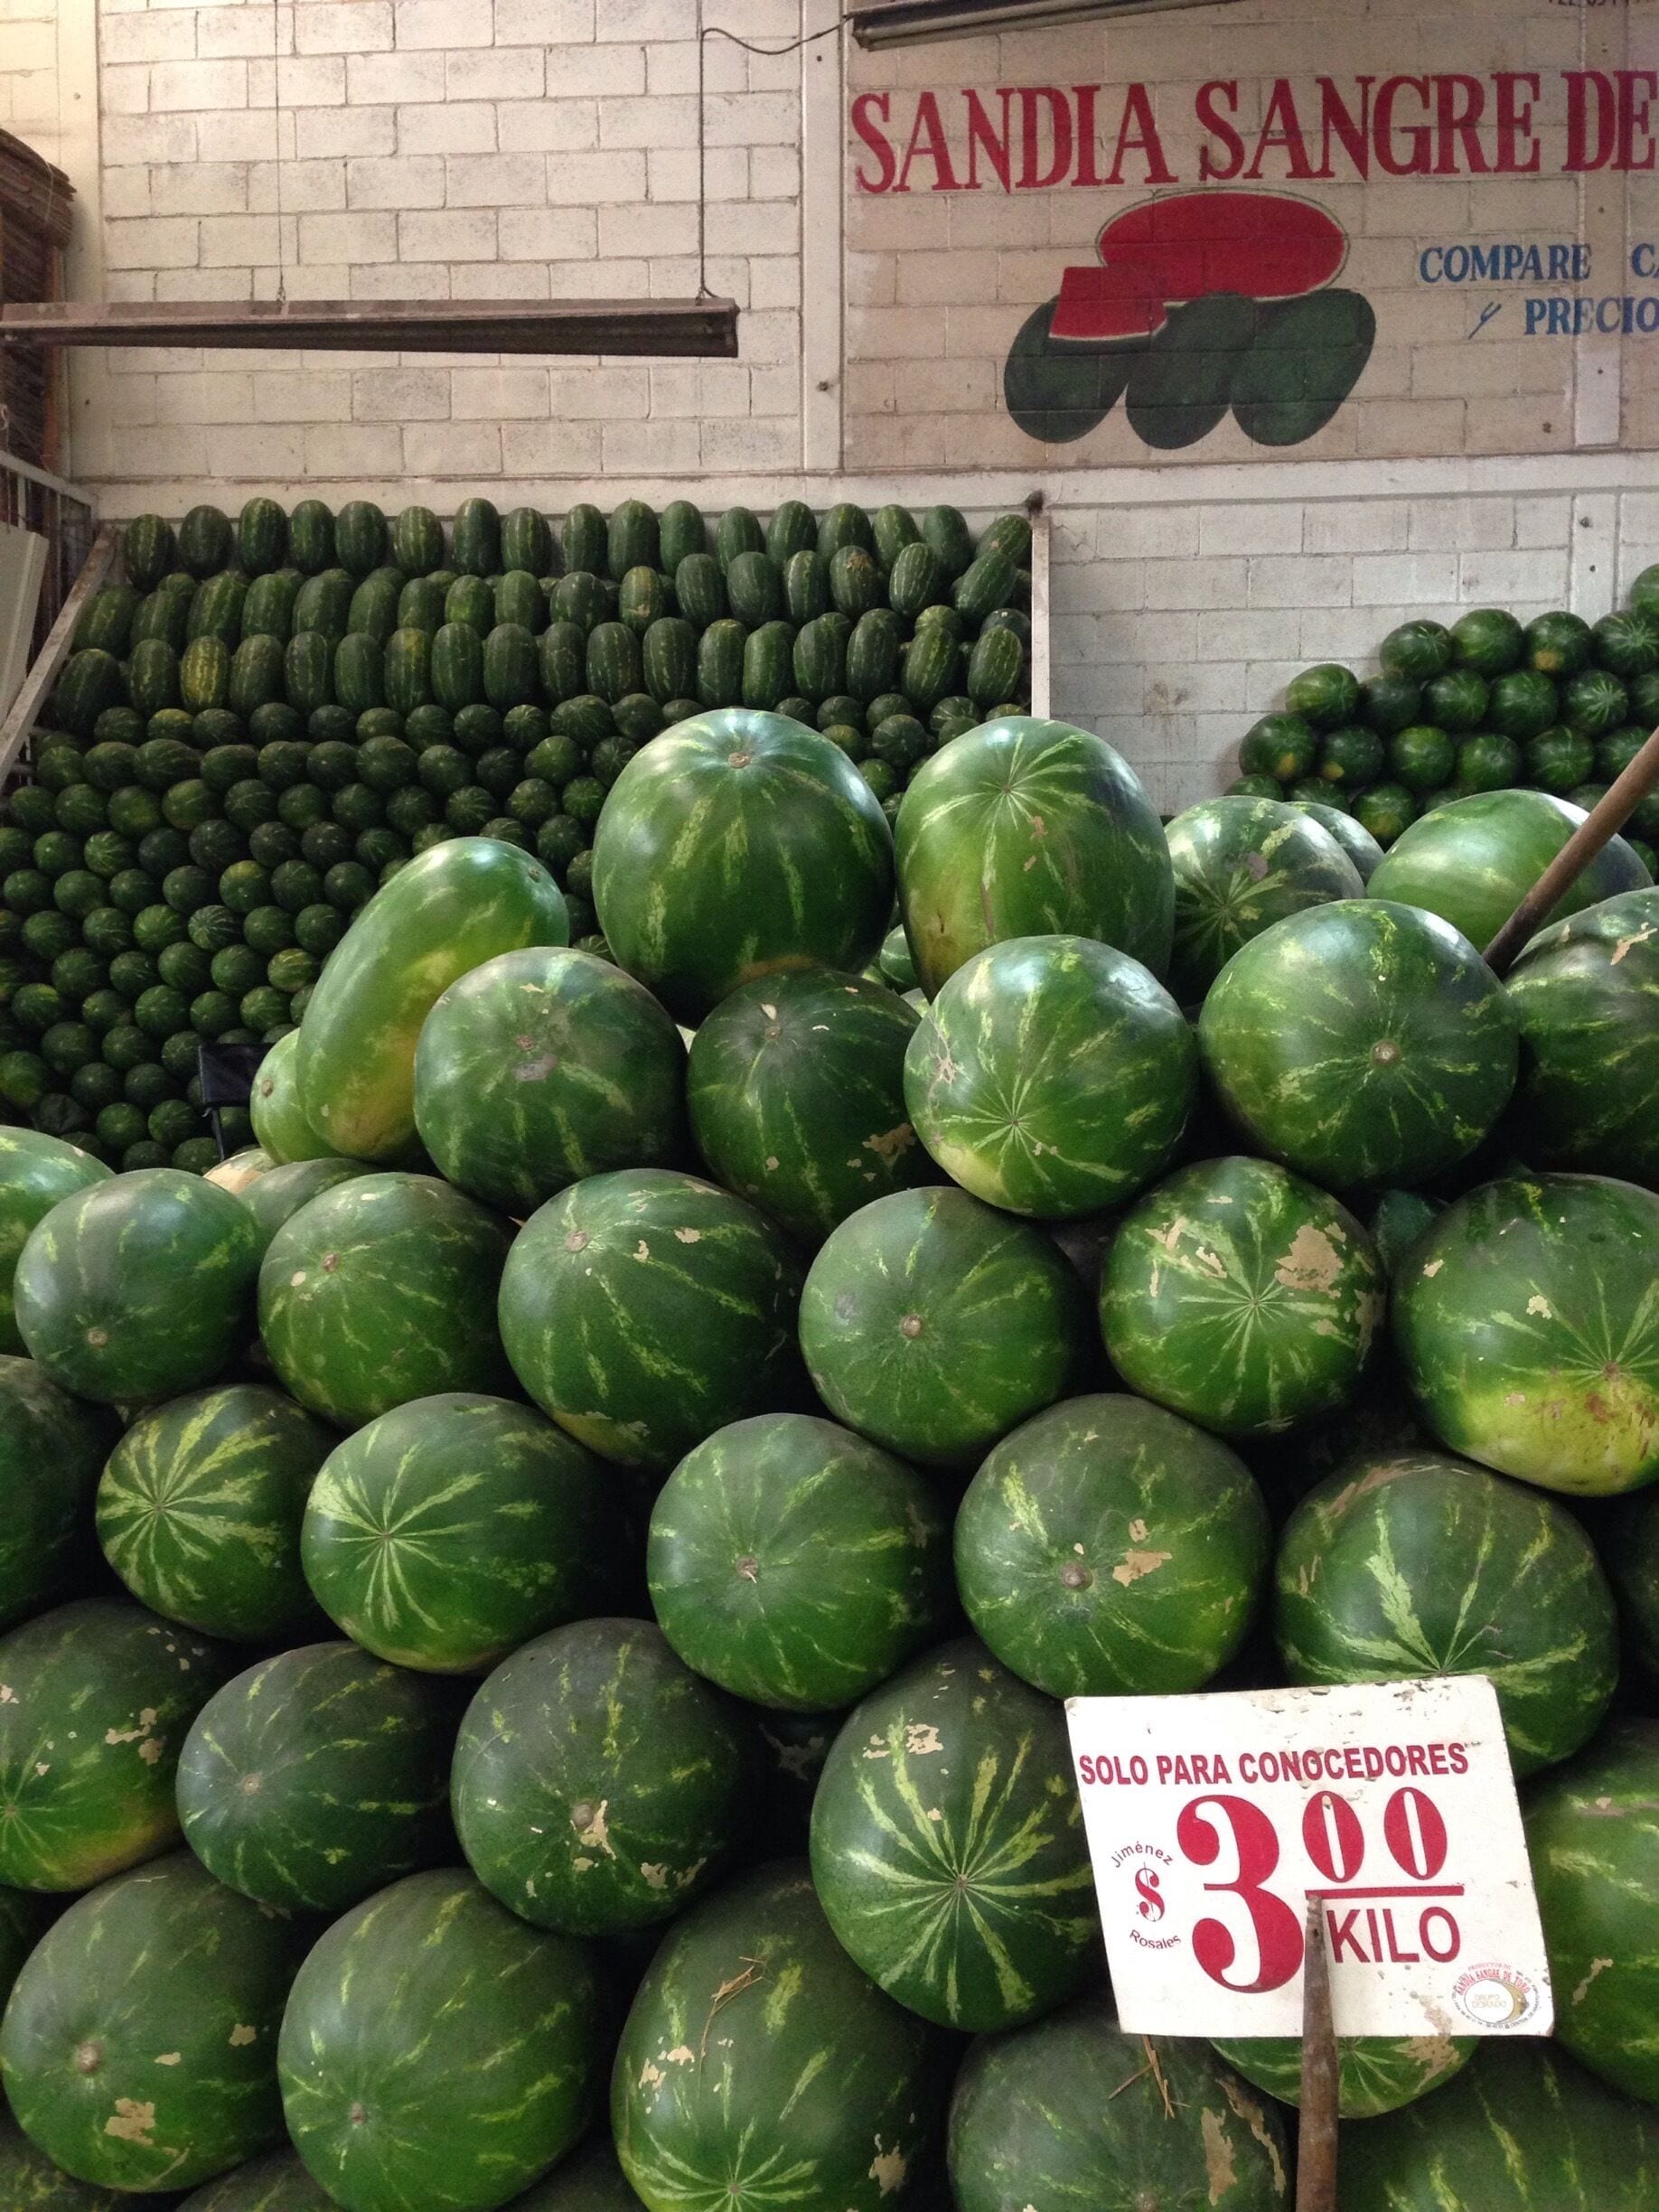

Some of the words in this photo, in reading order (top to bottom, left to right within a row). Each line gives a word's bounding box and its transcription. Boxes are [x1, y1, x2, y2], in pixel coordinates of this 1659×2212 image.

[851, 84, 1178, 193] SANDIA
[1195, 73, 1541, 181] SANGRE
[1561, 70, 1657, 172] DE
[1420, 243, 1592, 283] COMPARE
[1631, 242, 1659, 278] C
[1080, 1755, 1148, 1786] SOLO
[1157, 1753, 1233, 1785] PARA
[1238, 1742, 1469, 1784] CONOCEDORES
[1111, 1841, 1174, 1869] Jiménez
[1129, 1929, 1182, 1950] Rosales
[1326, 1907, 1461, 1964] KILO
